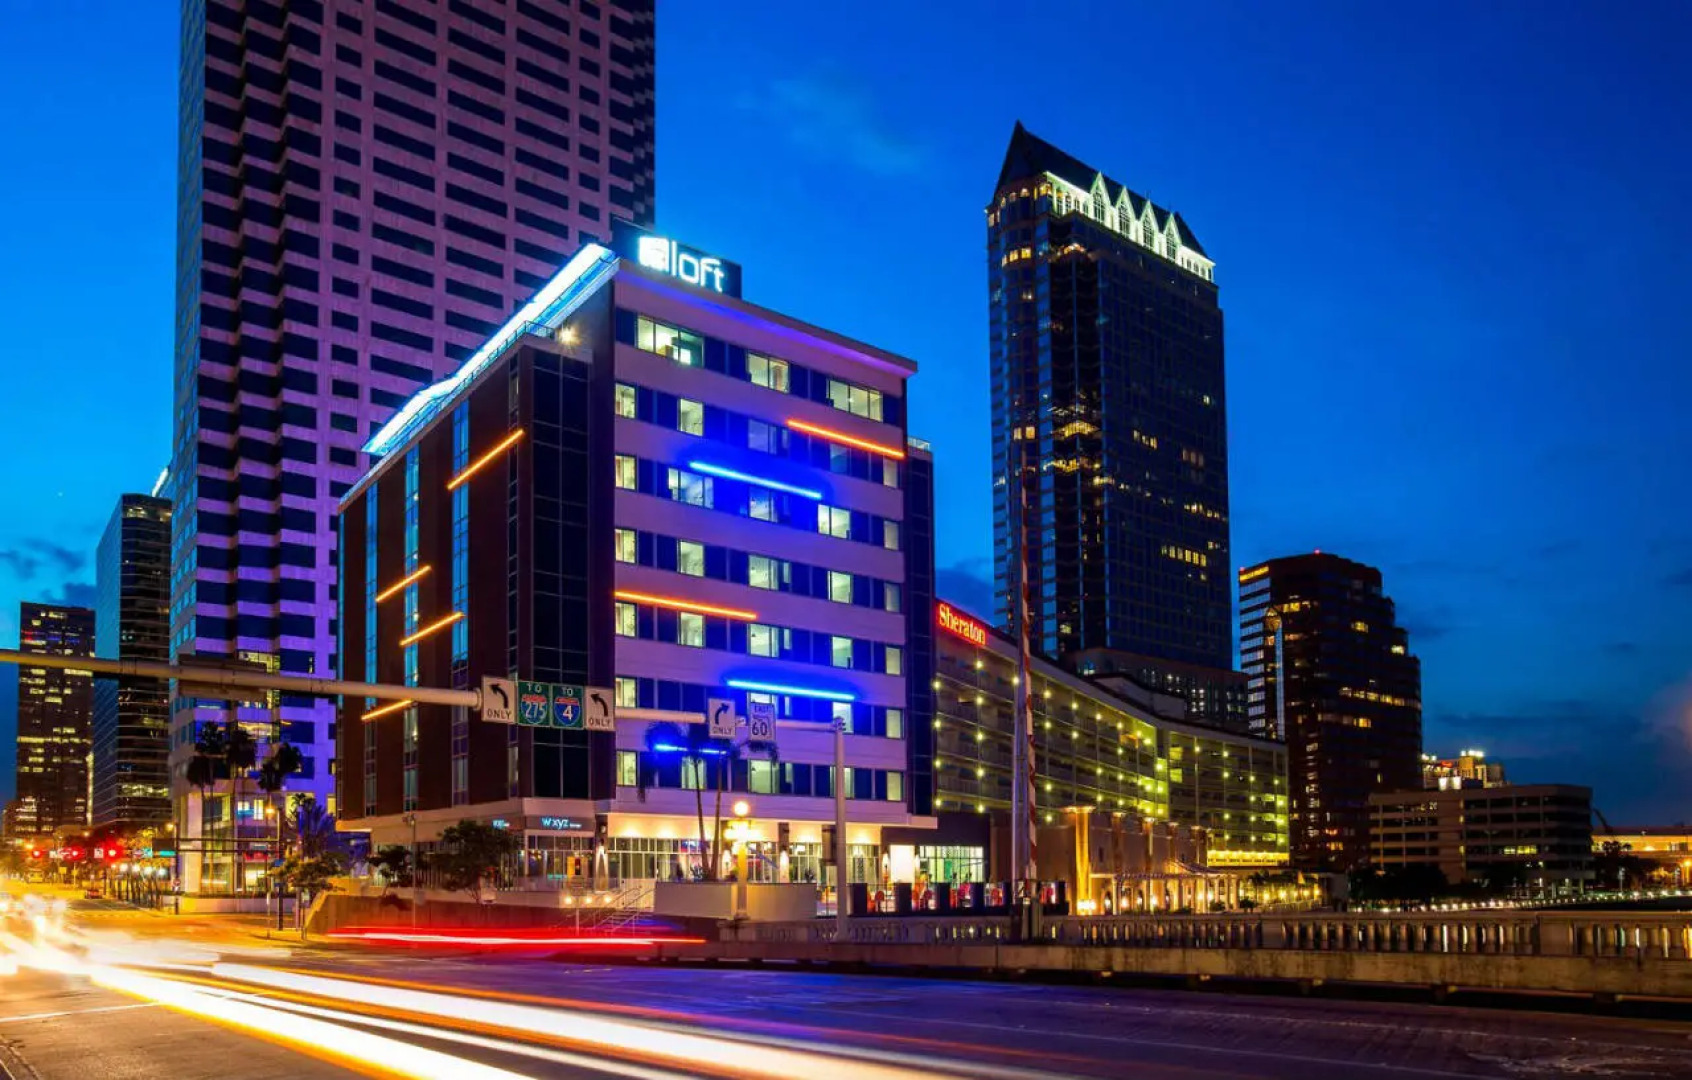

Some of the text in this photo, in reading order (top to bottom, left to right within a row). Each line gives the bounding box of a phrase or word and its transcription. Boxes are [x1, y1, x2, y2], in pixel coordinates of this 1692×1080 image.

[939, 603, 986, 645] Sheraton
[526, 682, 543, 694] TO
[561, 686, 574, 697] TO
[487, 708, 512, 720] ONLY
[525, 701, 546, 719] 275
[562, 705, 574, 721] 4
[588, 717, 611, 728] ONLY
[751, 721, 768, 736] 60
[712, 725, 732, 735] ONLY
